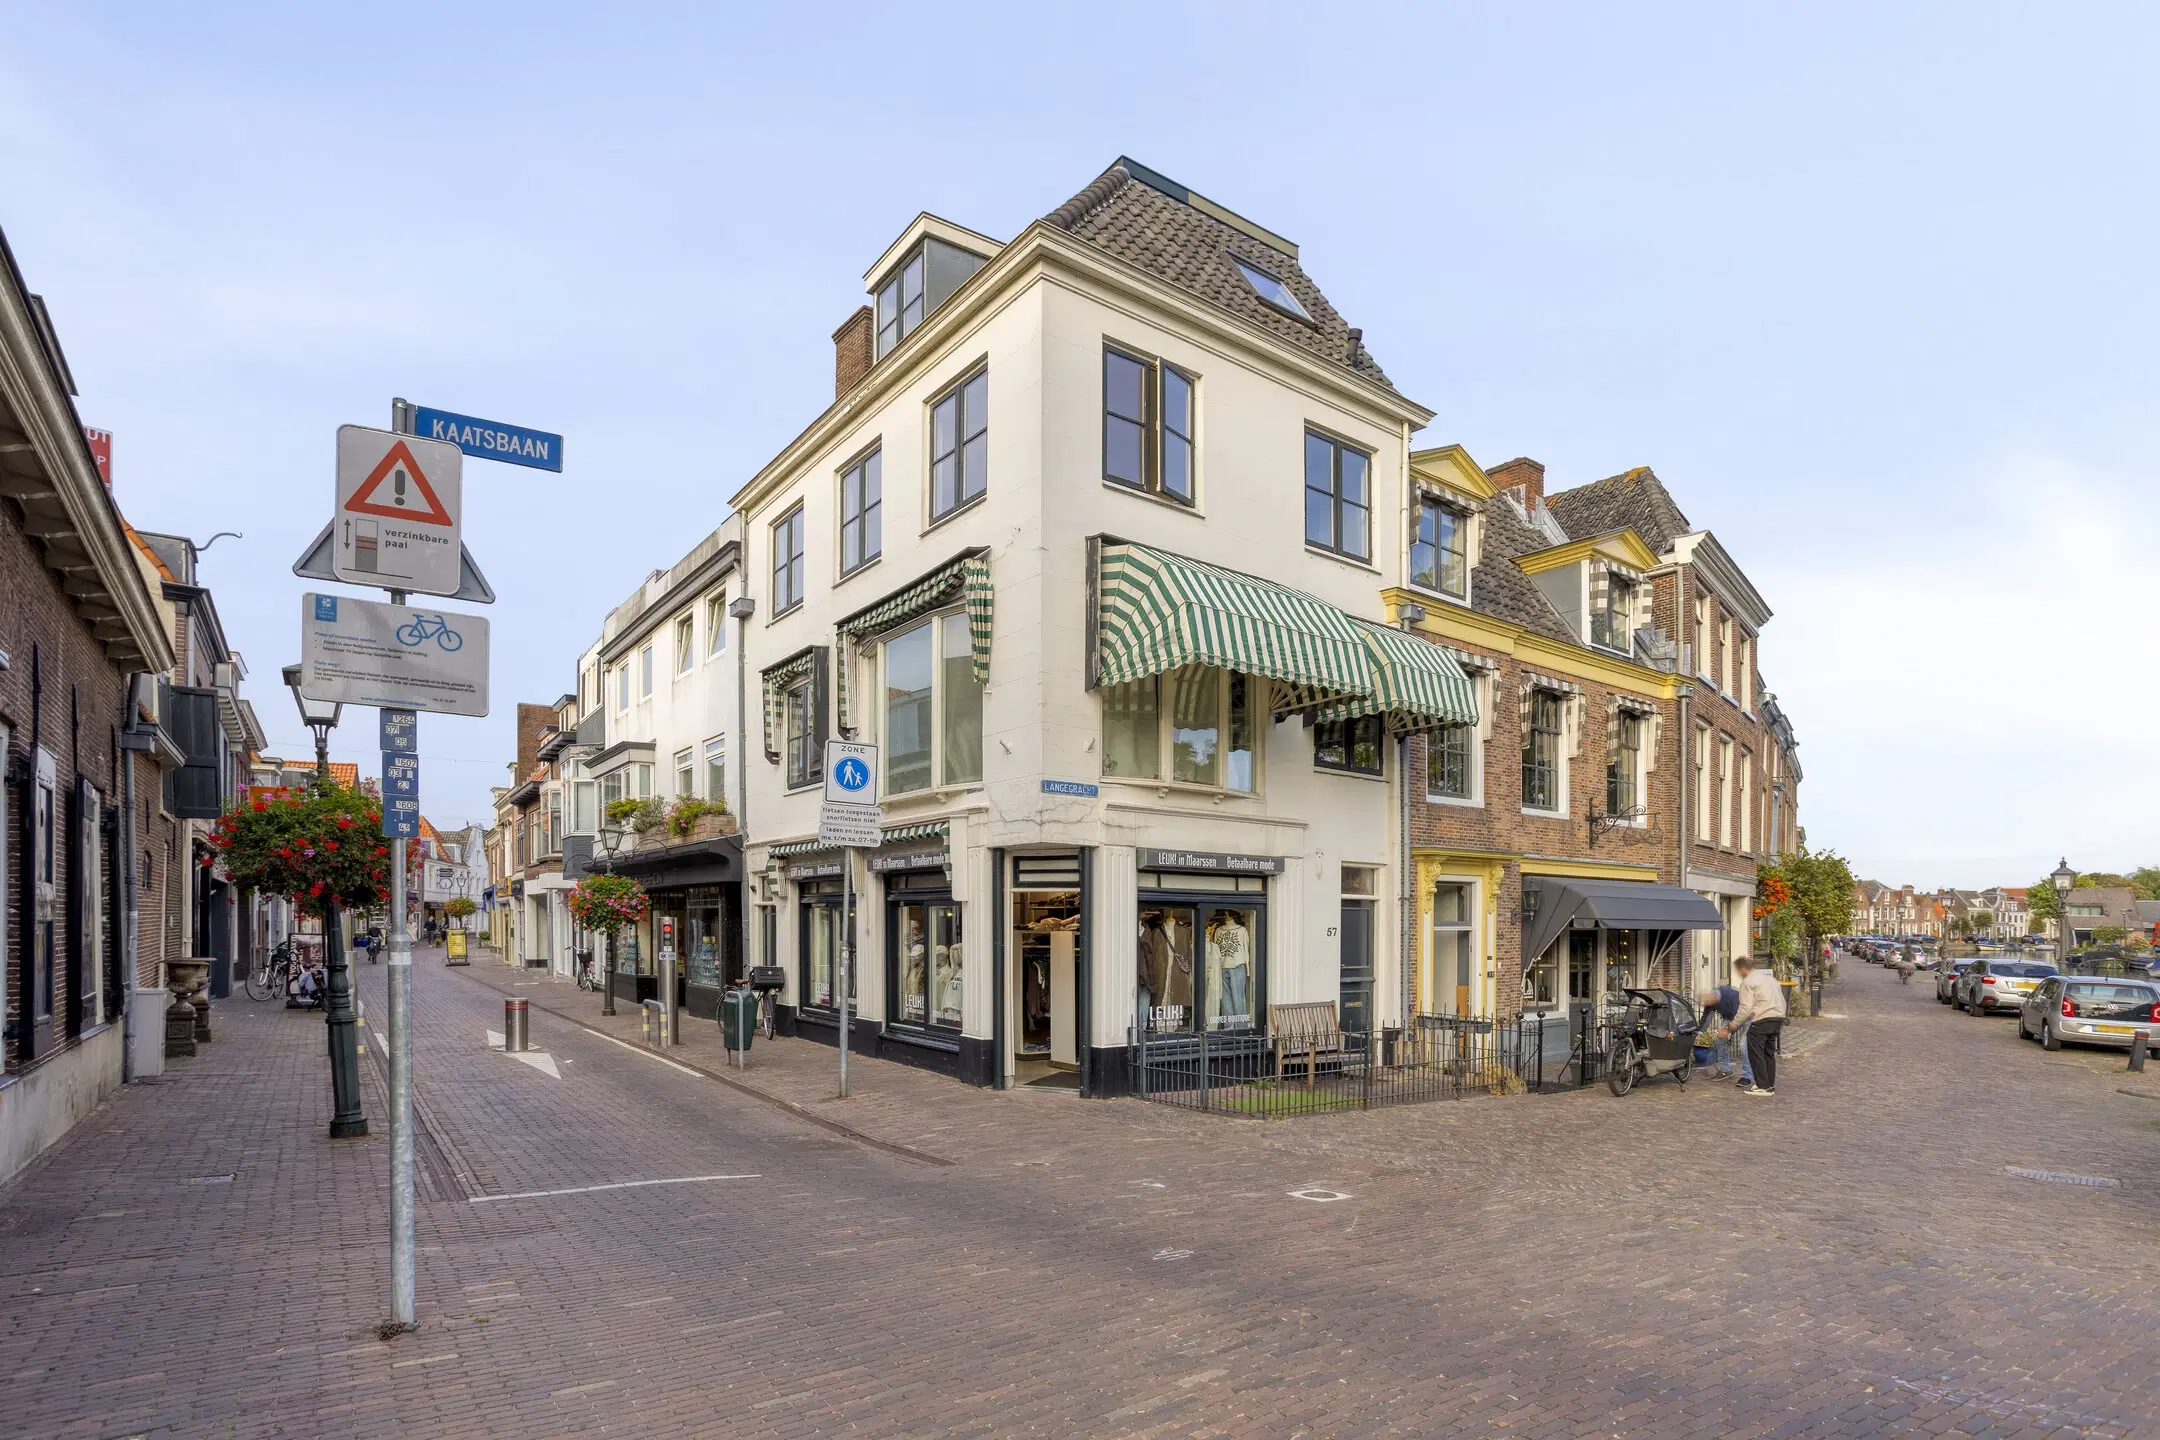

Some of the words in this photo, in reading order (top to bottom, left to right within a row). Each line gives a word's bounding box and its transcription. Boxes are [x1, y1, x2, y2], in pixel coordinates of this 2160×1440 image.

[432, 418, 549, 460] KAATSBAAN
[384, 528, 449, 545] verzinkbare
[385, 539, 409, 549] paal
[841, 745, 865, 754] ZONE
[398, 758, 417, 767] 1607
[1044, 781, 1096, 795] LANGEGRACHT
[846, 809, 881, 817] toegestaan
[826, 814, 862, 823] snorfietsen
[863, 816, 876, 824] niet
[853, 828, 875, 836] lossen
[834, 834, 847, 842] t/m
[910, 854, 933, 867] Betaalbare
[1158, 852, 1177, 865] LEUK!
[1178, 854, 1185, 866] in
[1186, 854, 1217, 868] Maarssen
[1227, 856, 1259, 870] Betaalbare
[1259, 859, 1275, 870] mode
[1326, 927, 1338, 937] 57
[904, 993, 925, 1007] LEUK!
[1149, 1004, 1184, 1020] LEUK!
[1227, 1014, 1251, 1023] BOUTIQUE
